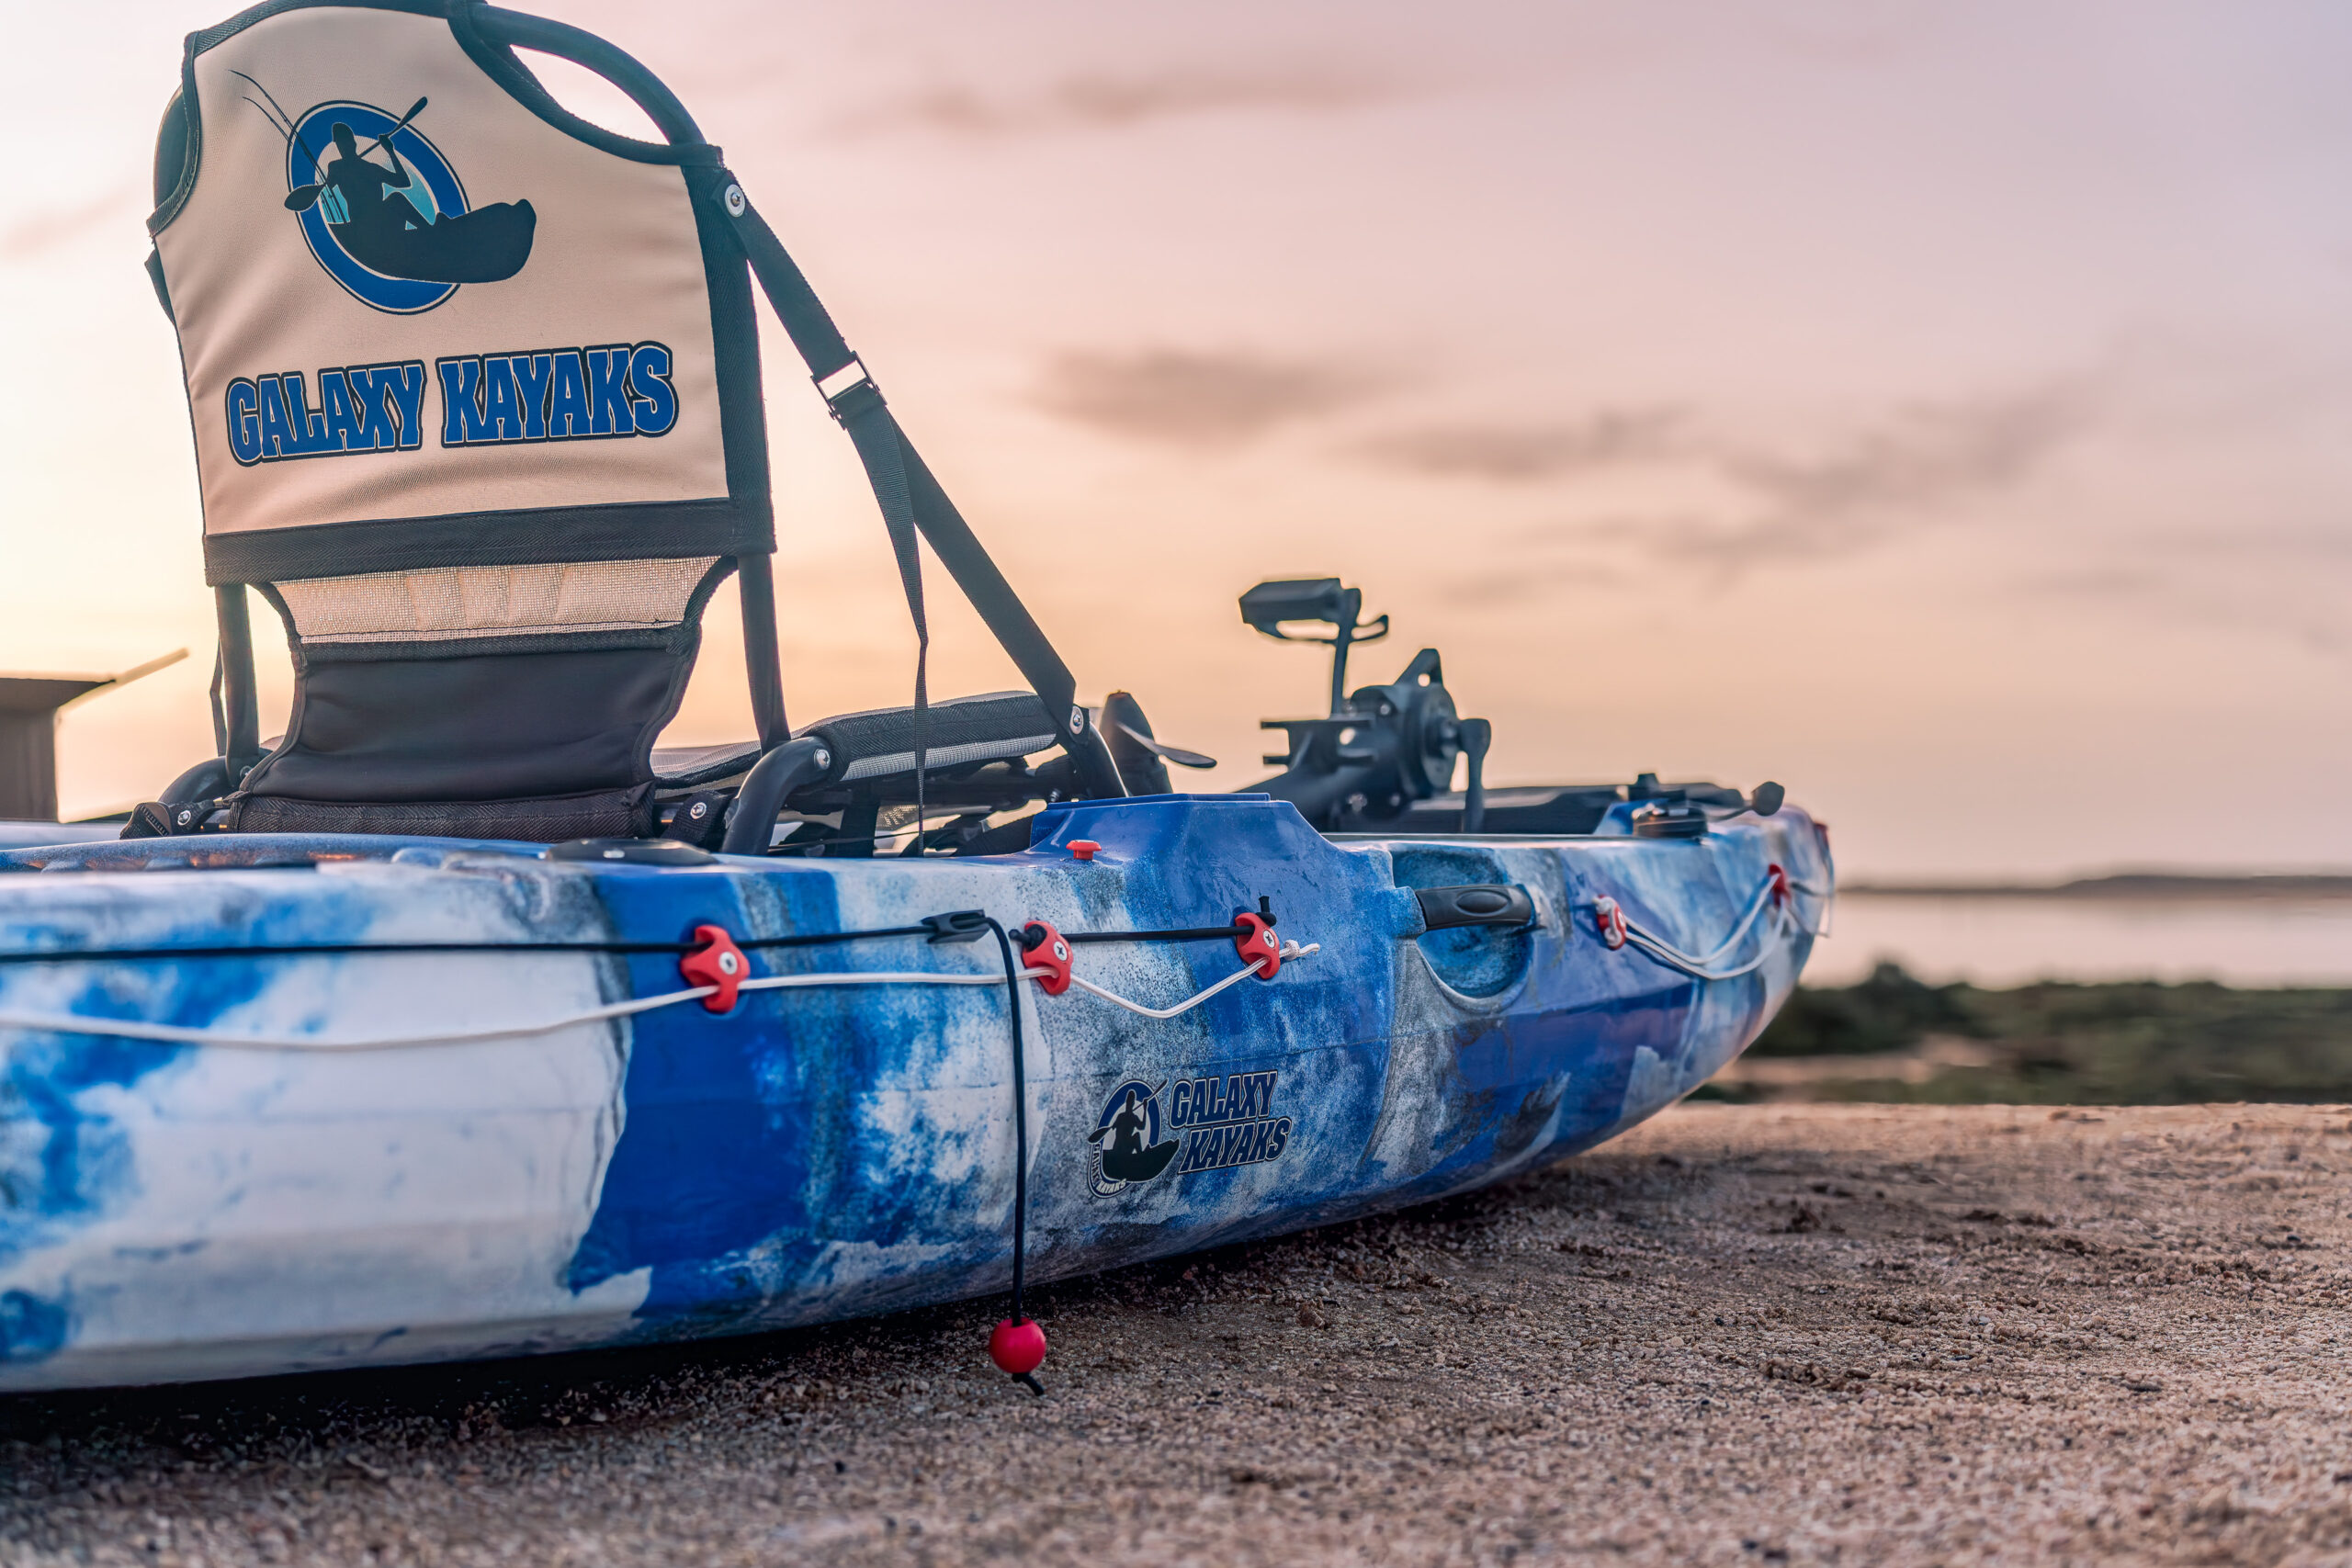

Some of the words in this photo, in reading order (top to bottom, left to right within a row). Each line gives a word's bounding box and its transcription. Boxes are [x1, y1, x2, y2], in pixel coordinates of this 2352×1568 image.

[226, 359, 427, 467] GALAXY
[435, 341, 679, 447] KAYAKS
[1170, 1069, 1278, 1129] GALAXY
[1178, 1116, 1292, 1175] KAYAKS
[1096, 1178, 1126, 1193] KAYAKS
